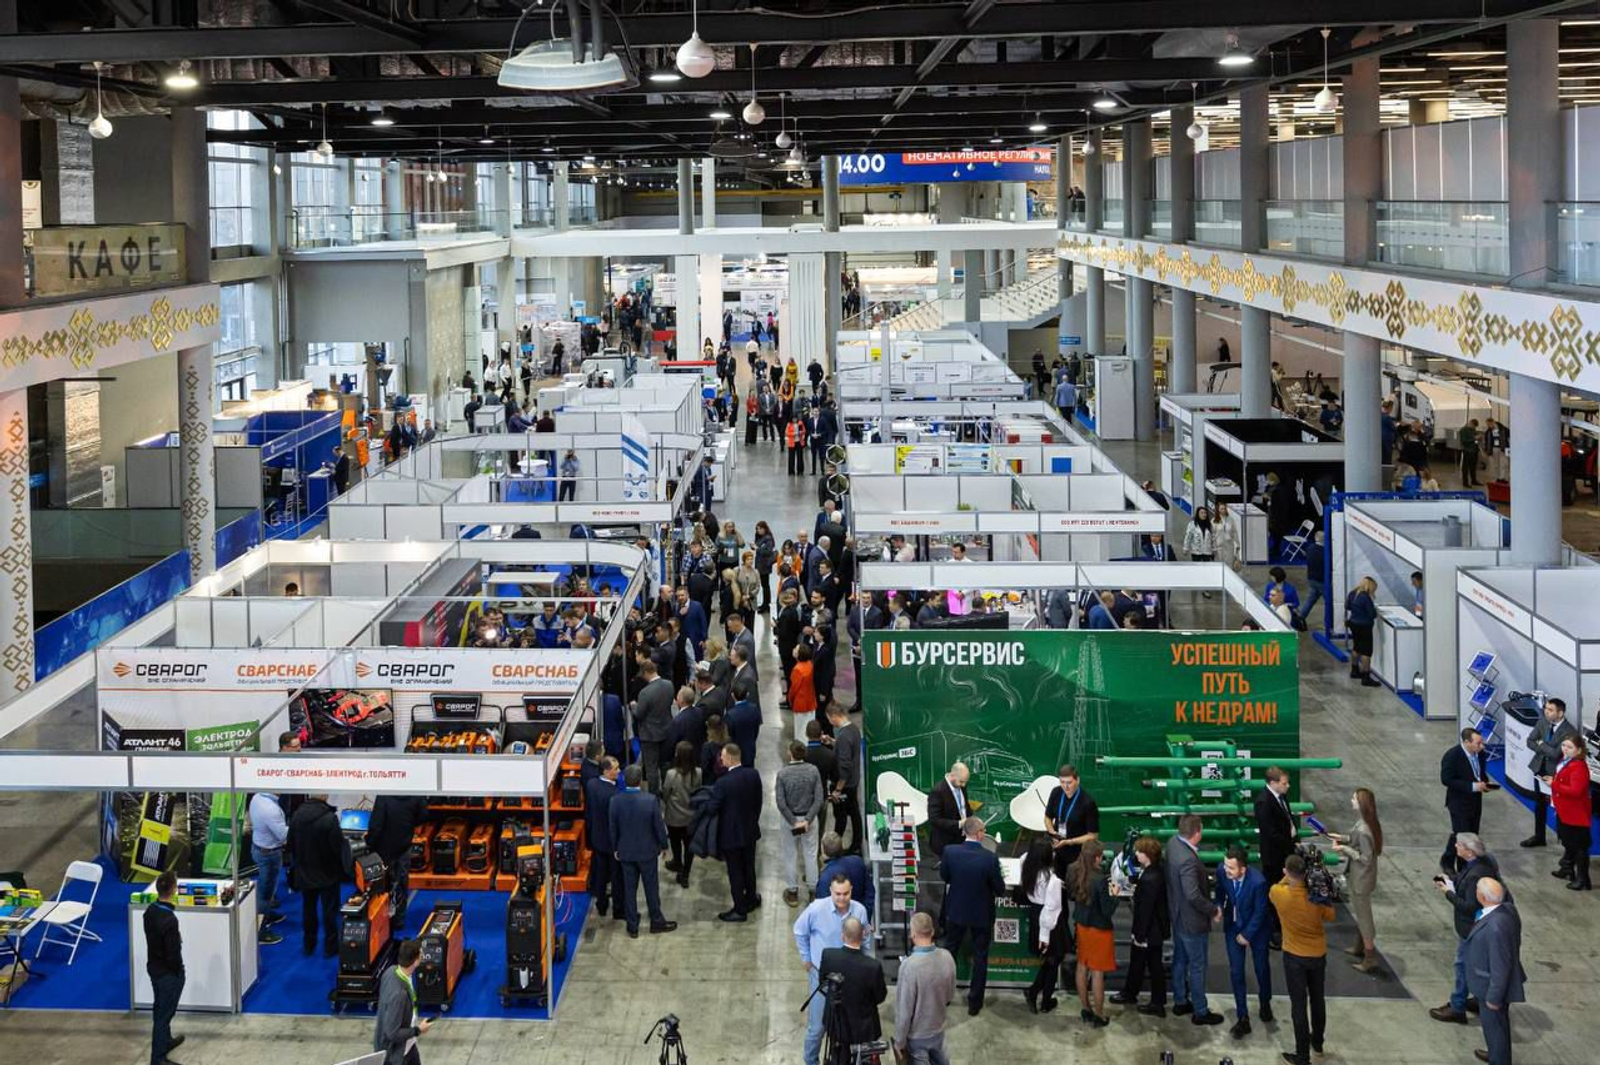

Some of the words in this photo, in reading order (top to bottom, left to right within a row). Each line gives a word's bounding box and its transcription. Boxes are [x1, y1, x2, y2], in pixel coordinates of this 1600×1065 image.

[838, 154, 886, 173] 14.00
[68, 236, 162, 279] КАФЕ
[901, 642, 1025, 666] БУРСЕРВИС
[1171, 640, 1280, 666] УСПЕШНЫЙ
[136, 664, 207, 676] СВАРОГ
[237, 664, 317, 677] СВАРСНАБ
[378, 664, 455, 677] СВАРОГ
[492, 665, 578, 678] СВАРСНАБ
[1202, 672, 1250, 694] ПУТЬ
[1176, 701, 1188, 722] К
[1192, 701, 1277, 726] НЕДРАМ!
[123, 738, 168, 746] АТЛАНТ
[168, 737, 181, 747] 46
[195, 728, 253, 744] ЭЛЕКТРОД
